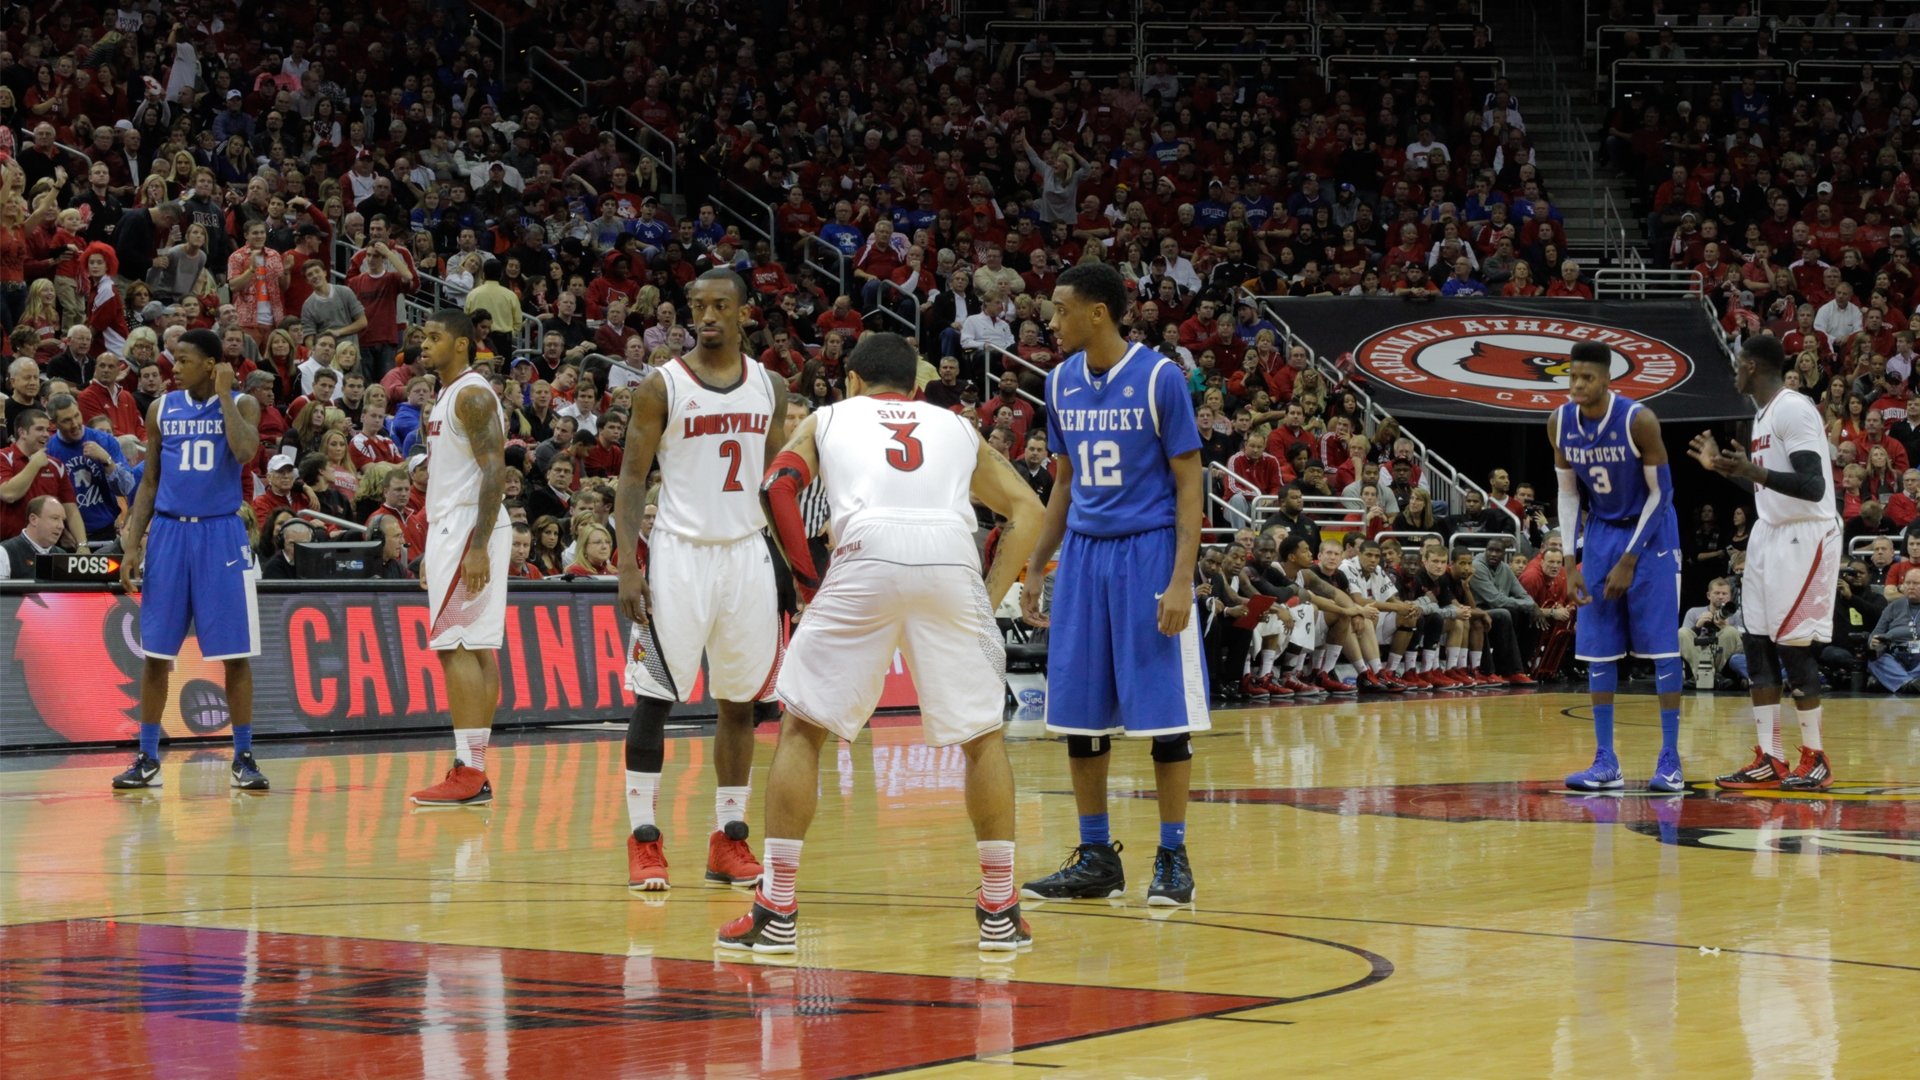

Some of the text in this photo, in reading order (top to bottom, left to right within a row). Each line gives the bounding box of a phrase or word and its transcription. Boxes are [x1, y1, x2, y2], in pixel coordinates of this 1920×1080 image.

[1370, 319, 1677, 384] CARDINAL ATHLETIC FUND
[683, 413, 769, 439] LOUISVILLE
[877, 409, 917, 419] SIVA
[1058, 408, 1145, 431] KENTUCKY
[162, 419, 224, 436] KENTUCK
[179, 439, 215, 472] 10
[879, 422, 924, 473] 3
[1565, 446, 1626, 465] KENTUCKY
[719, 439, 744, 492] 2
[1078, 440, 1123, 487] 12
[1588, 465, 1613, 494] 3
[68, 556, 109, 574] POSS
[1024, 691, 1044, 704] Ford
